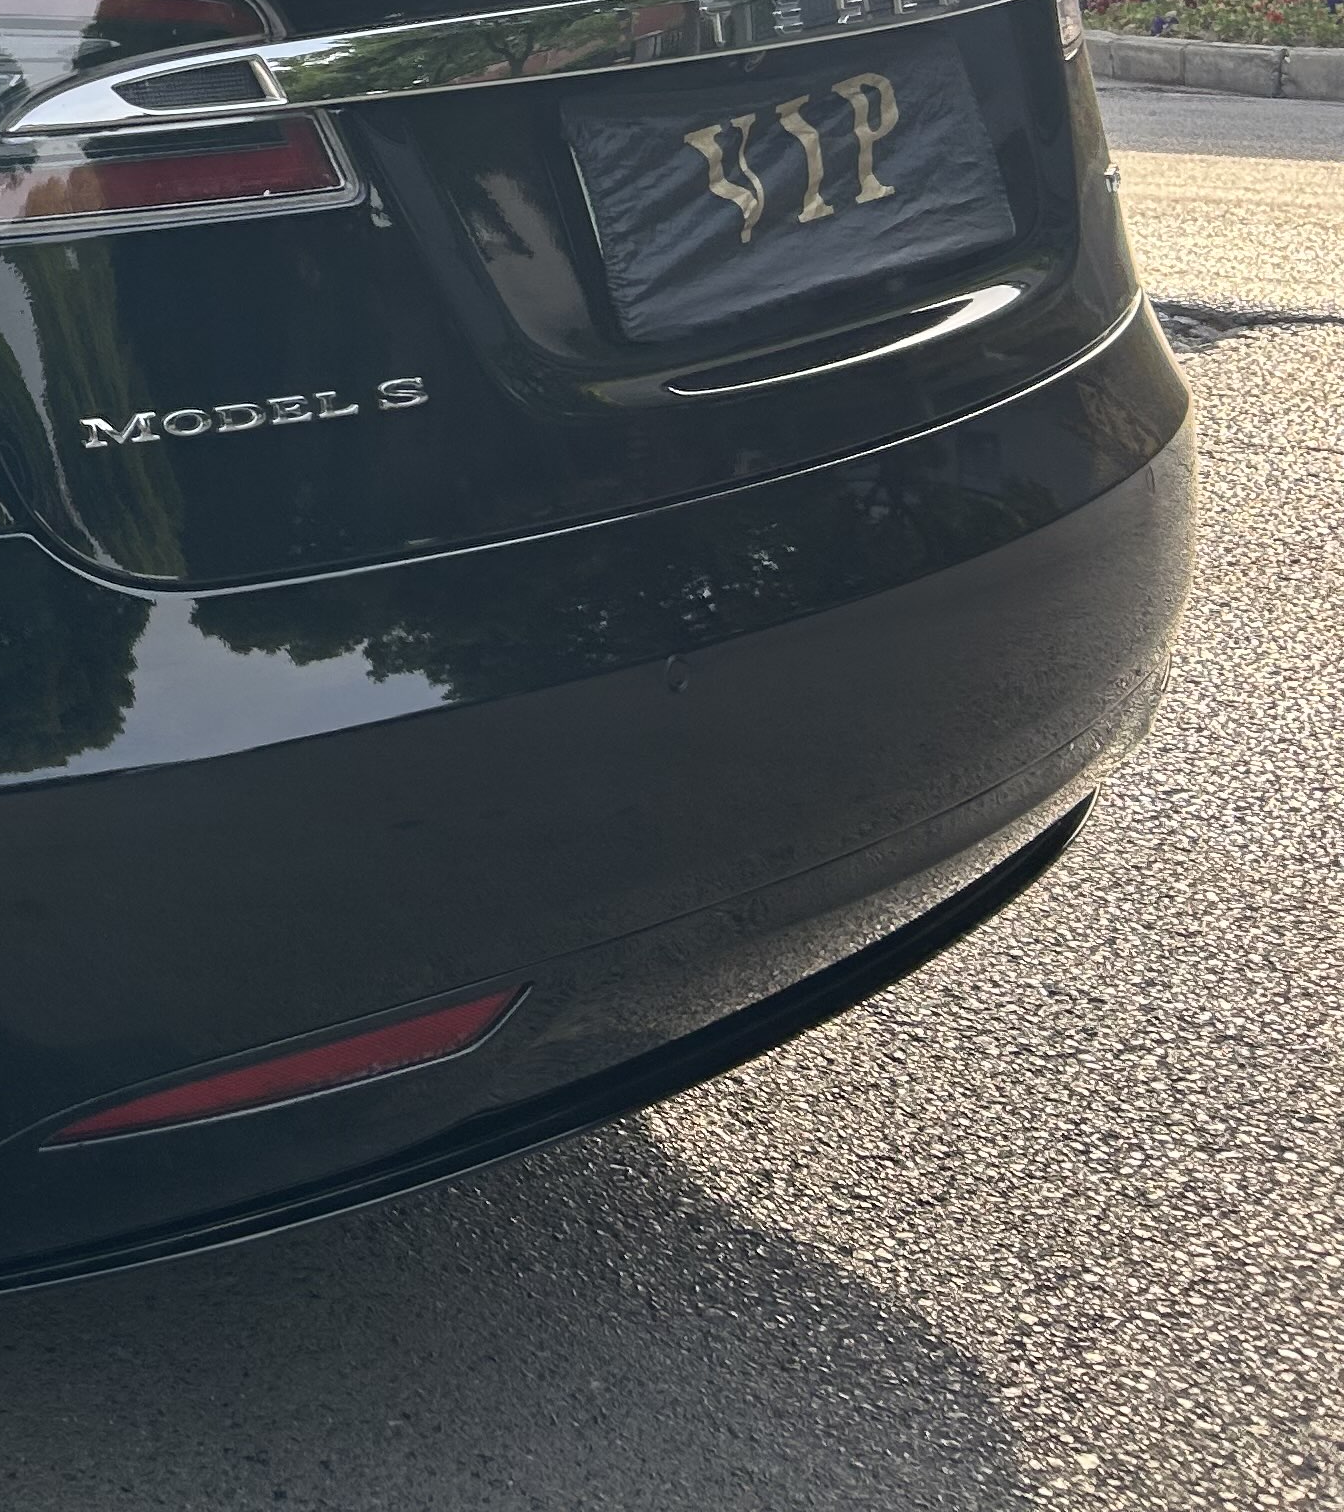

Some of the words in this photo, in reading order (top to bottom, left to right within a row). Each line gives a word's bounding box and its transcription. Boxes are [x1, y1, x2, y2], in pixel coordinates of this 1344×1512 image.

[684, 73, 899, 243] VIP
[78, 390, 359, 449] MODEL
[377, 377, 429, 410] S
